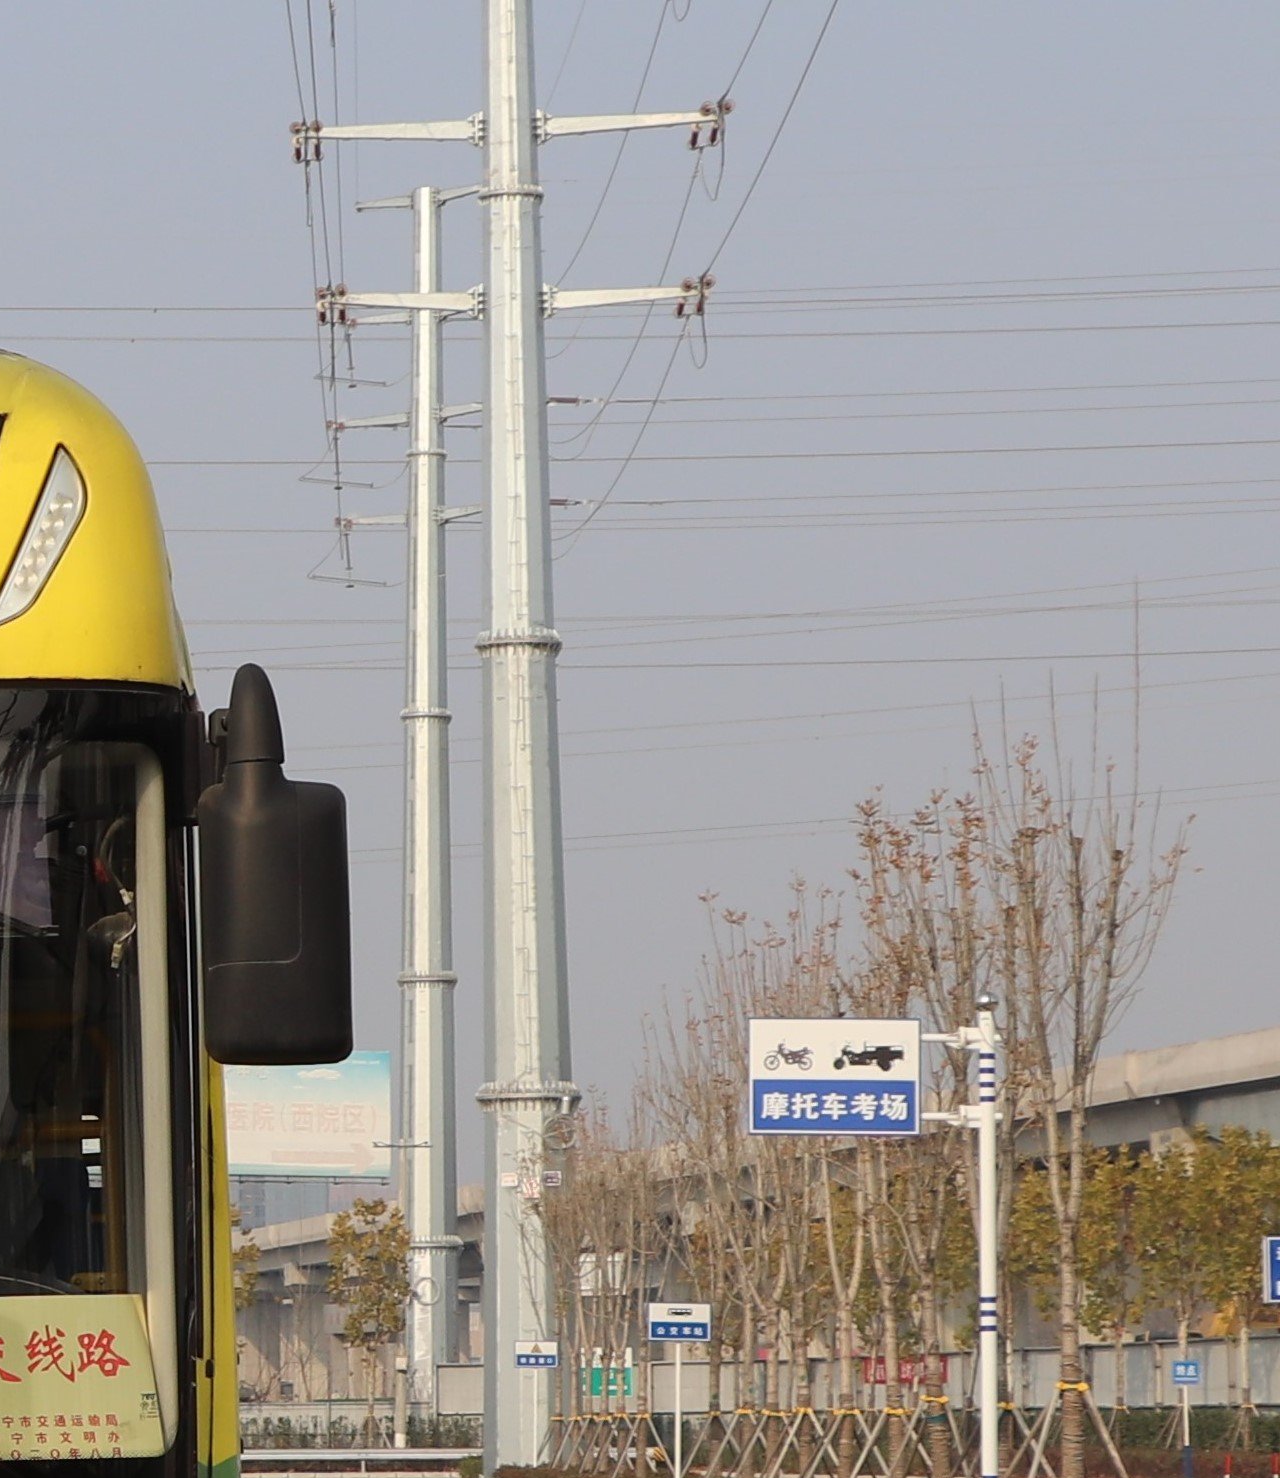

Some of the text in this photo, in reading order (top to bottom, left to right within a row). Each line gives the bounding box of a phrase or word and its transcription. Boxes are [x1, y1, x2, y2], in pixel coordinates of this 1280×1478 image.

[761, 1092, 908, 1121] 摩托车考场
